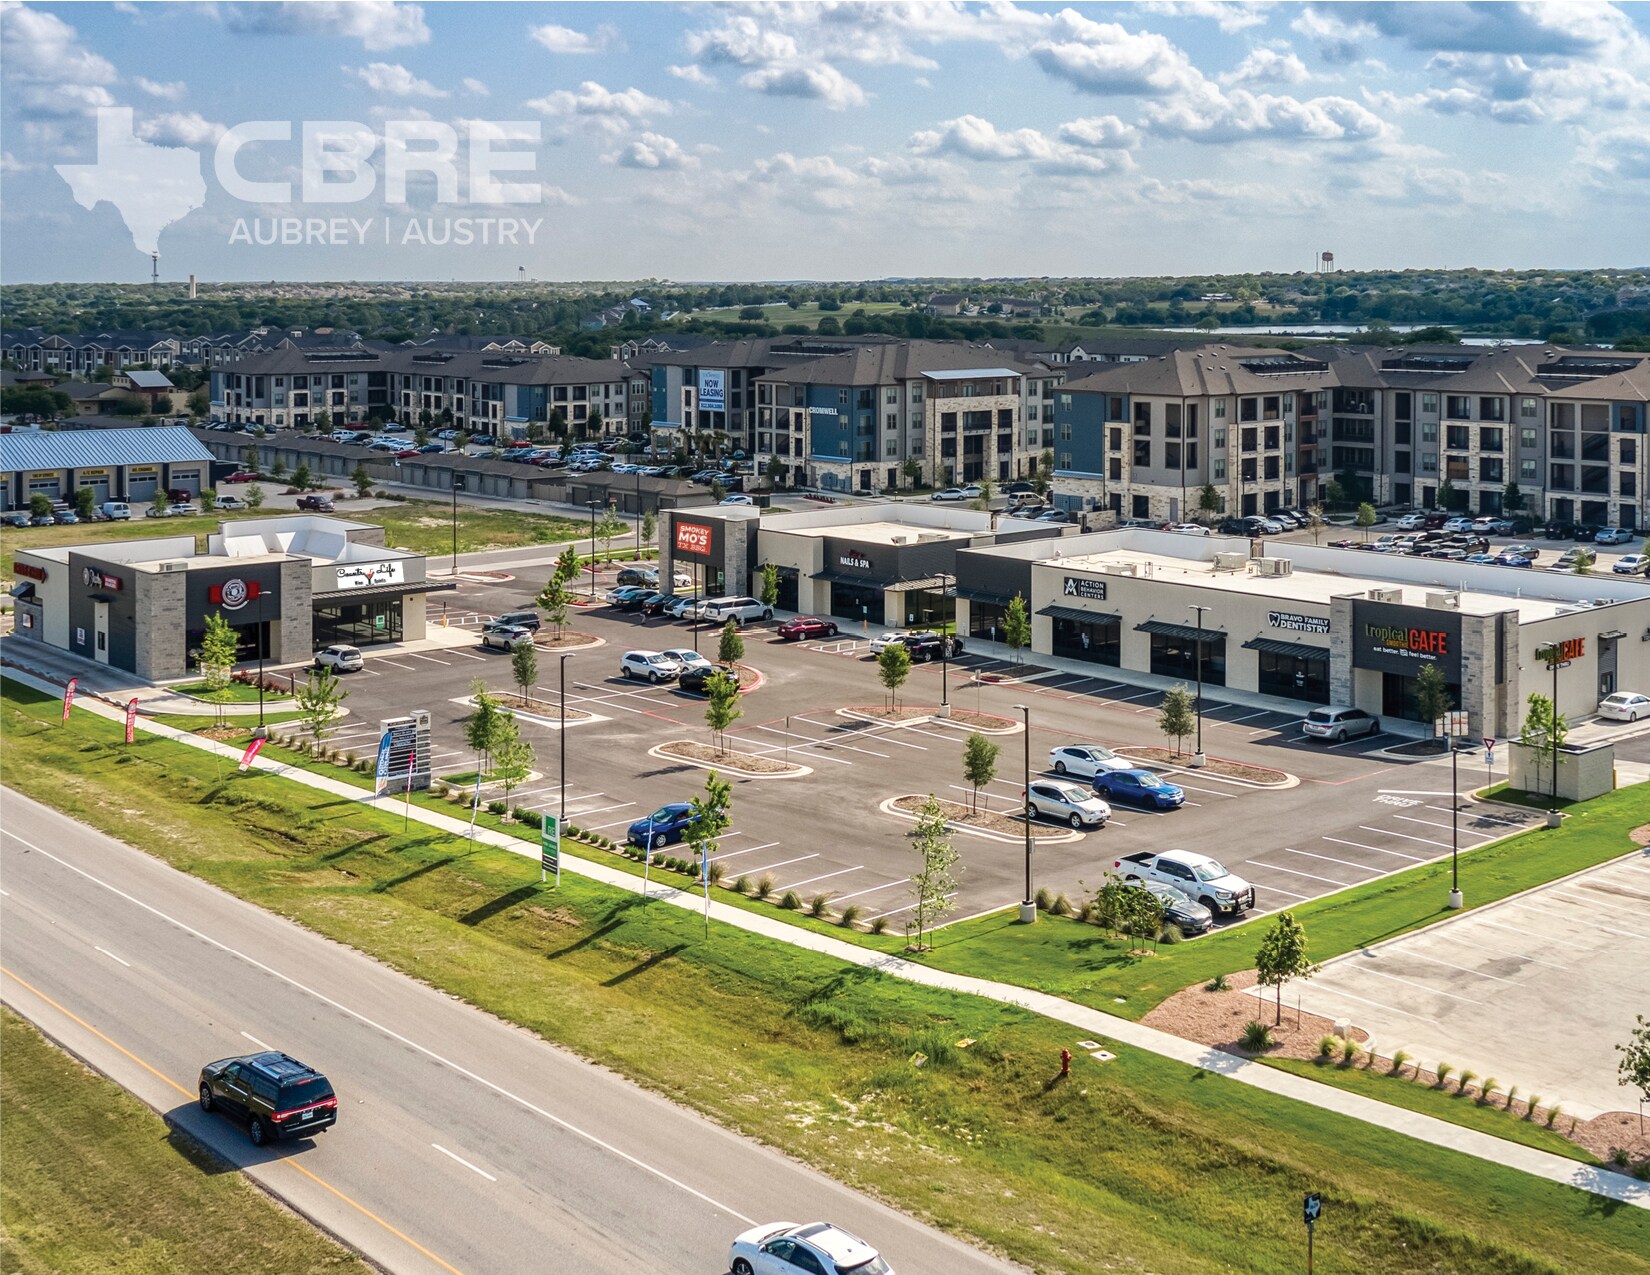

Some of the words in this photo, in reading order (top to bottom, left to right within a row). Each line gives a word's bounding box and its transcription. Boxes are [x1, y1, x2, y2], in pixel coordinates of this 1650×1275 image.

[705, 379, 719, 388] NOW
[700, 388, 724, 397] LEASING
[808, 406, 838, 415] CROMWELL
[680, 525, 710, 535] SMOKEY
[678, 532, 707, 545] MO'S
[840, 556, 854, 566] NAILS
[854, 558, 859, 567] &
[859, 559, 870, 569] SPA
[376, 563, 396, 577] Life
[1080, 580, 1104, 589] ACTION
[1080, 592, 1104, 600] CENTERS
[1281, 614, 1303, 622] BRAVO
[1304, 616, 1329, 626] FAMILY
[1280, 621, 1329, 633] DENTISTRY
[1365, 623, 1408, 641] tropical
[1409, 629, 1448, 654] CAFE
[1382, 647, 1399, 655] better.
[1563, 637, 1585, 660] CAFE
